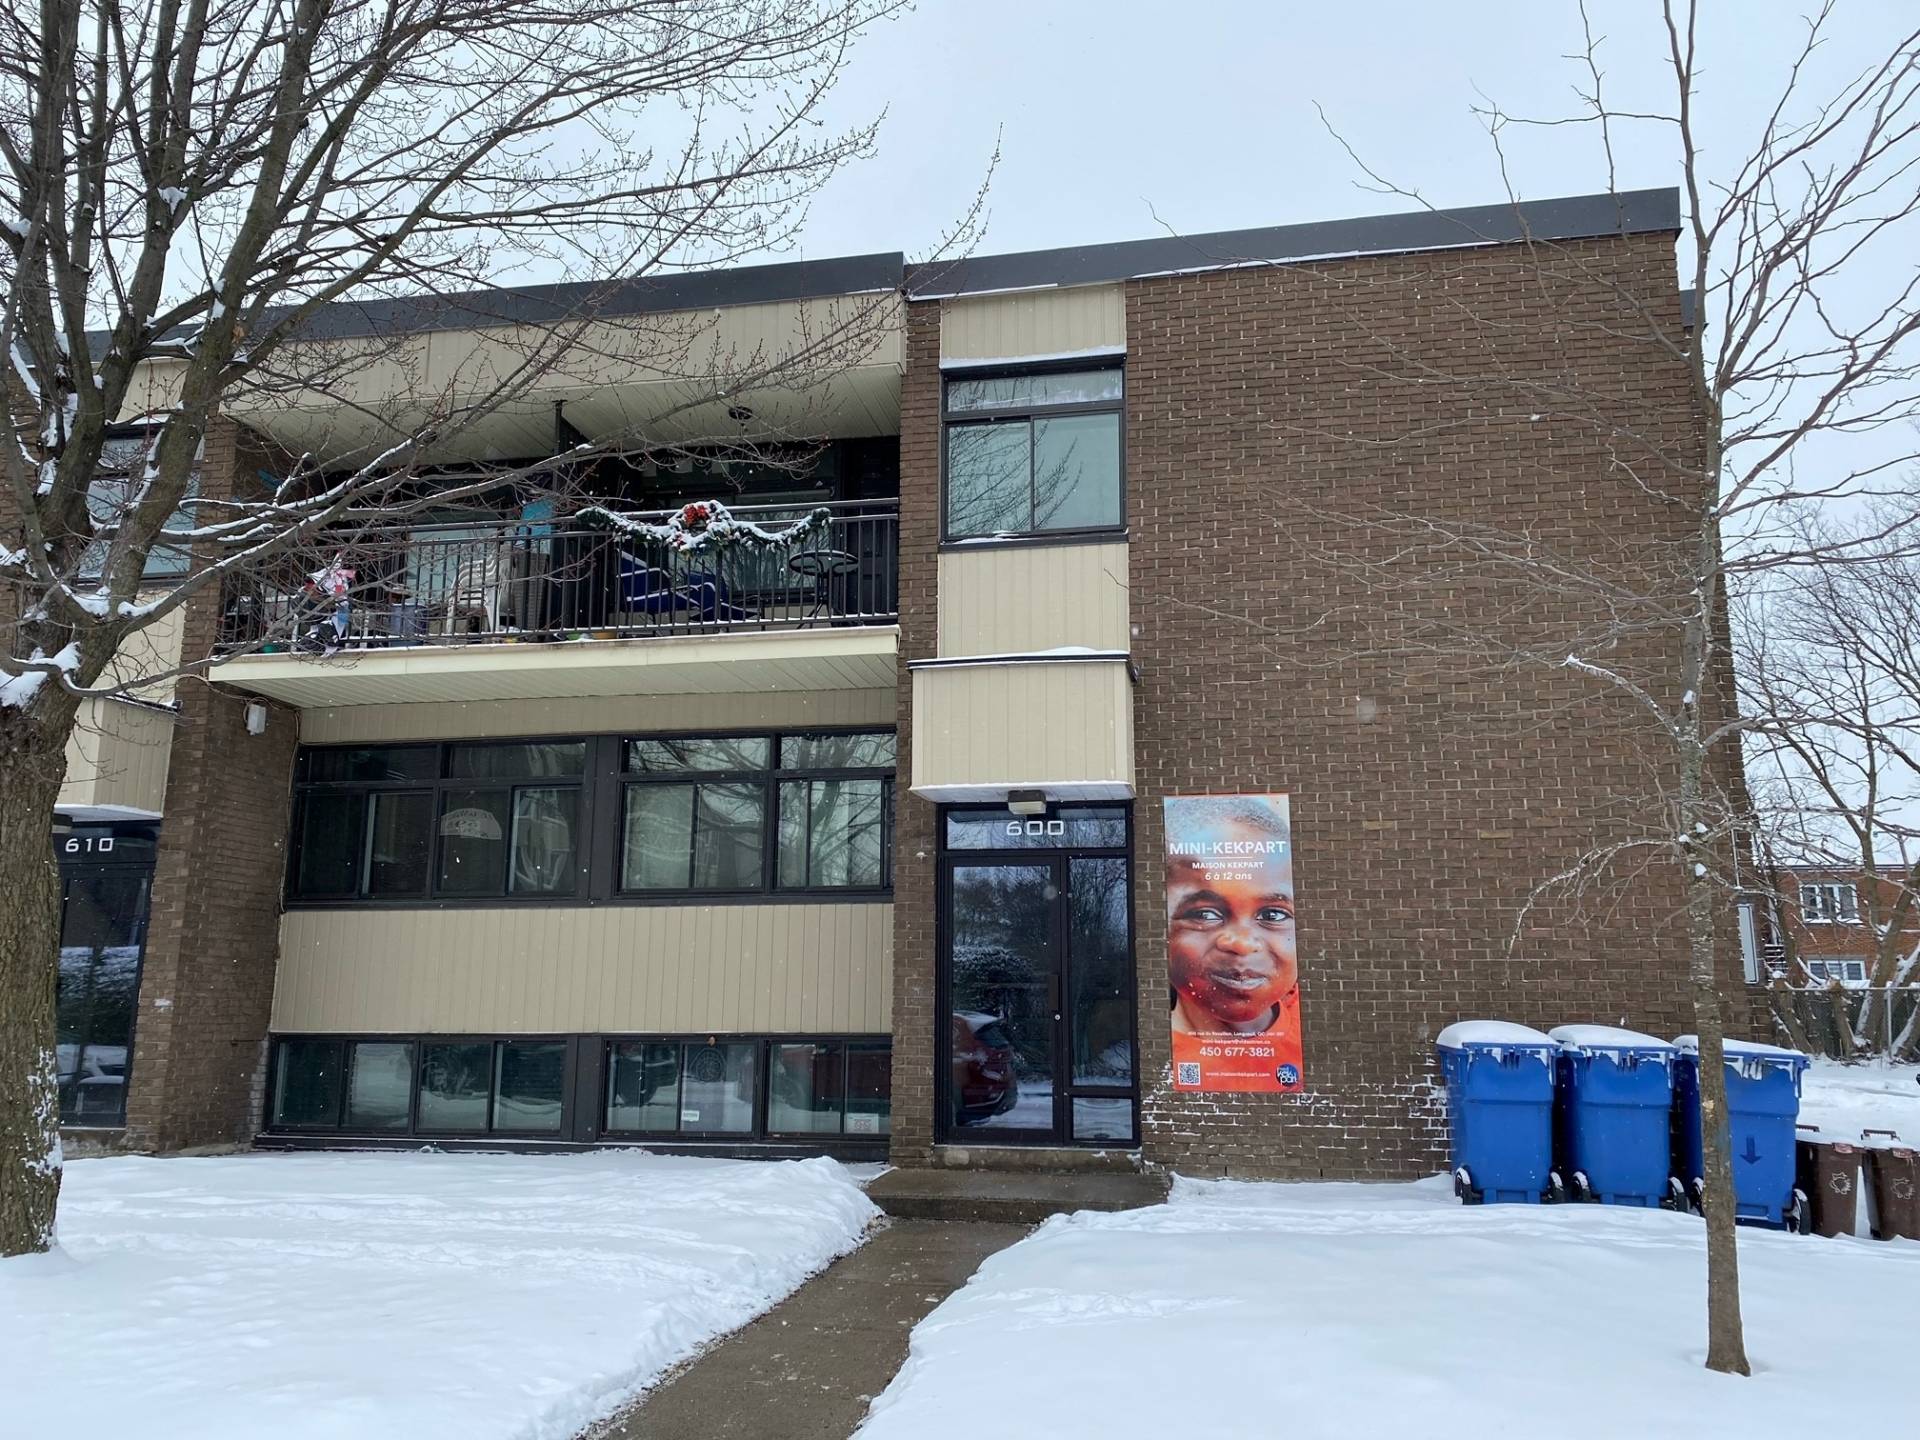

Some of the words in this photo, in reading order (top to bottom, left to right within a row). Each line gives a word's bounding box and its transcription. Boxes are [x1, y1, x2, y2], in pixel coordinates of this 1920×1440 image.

[1006, 820, 1064, 836] 600
[65, 837, 114, 852] 610
[1169, 840, 1287, 855] MINI-KEKPART
[1192, 861, 1226, 870] MAISON
[1227, 861, 1265, 869] KEKPART
[1205, 872, 1211, 881] 6
[1213, 871, 1220, 880] à
[1223, 871, 1233, 880] 12
[1234, 872, 1252, 880] ans
[1199, 1046, 1221, 1057] 450
[1224, 1046, 1275, 1057] 677-3821
